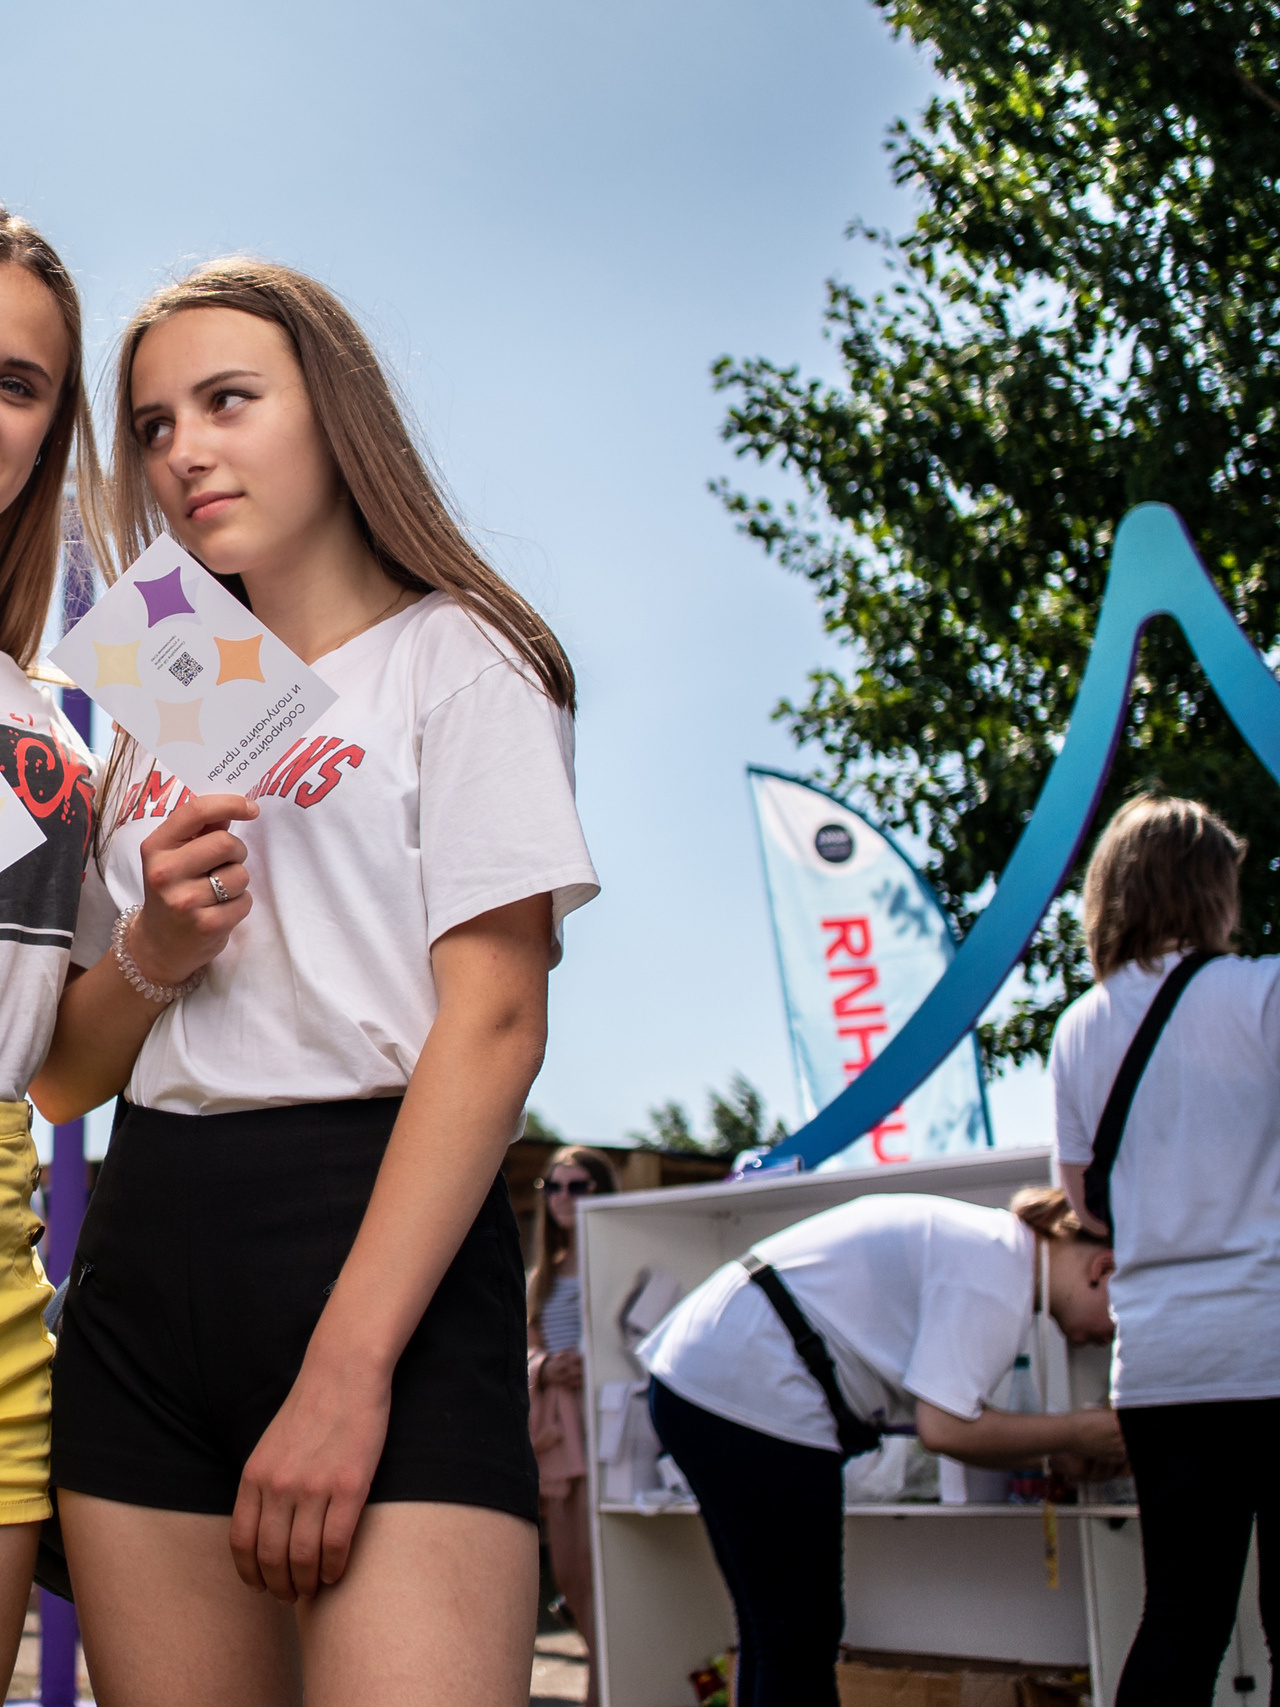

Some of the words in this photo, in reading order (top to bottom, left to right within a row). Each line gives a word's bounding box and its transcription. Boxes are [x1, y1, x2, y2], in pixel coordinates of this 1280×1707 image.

[291, 684, 302, 694] и
[239, 692, 293, 748] получайте
[248, 703, 306, 760] Собирайте
[207, 747, 241, 782] призы
[225, 759, 250, 785] юлы
